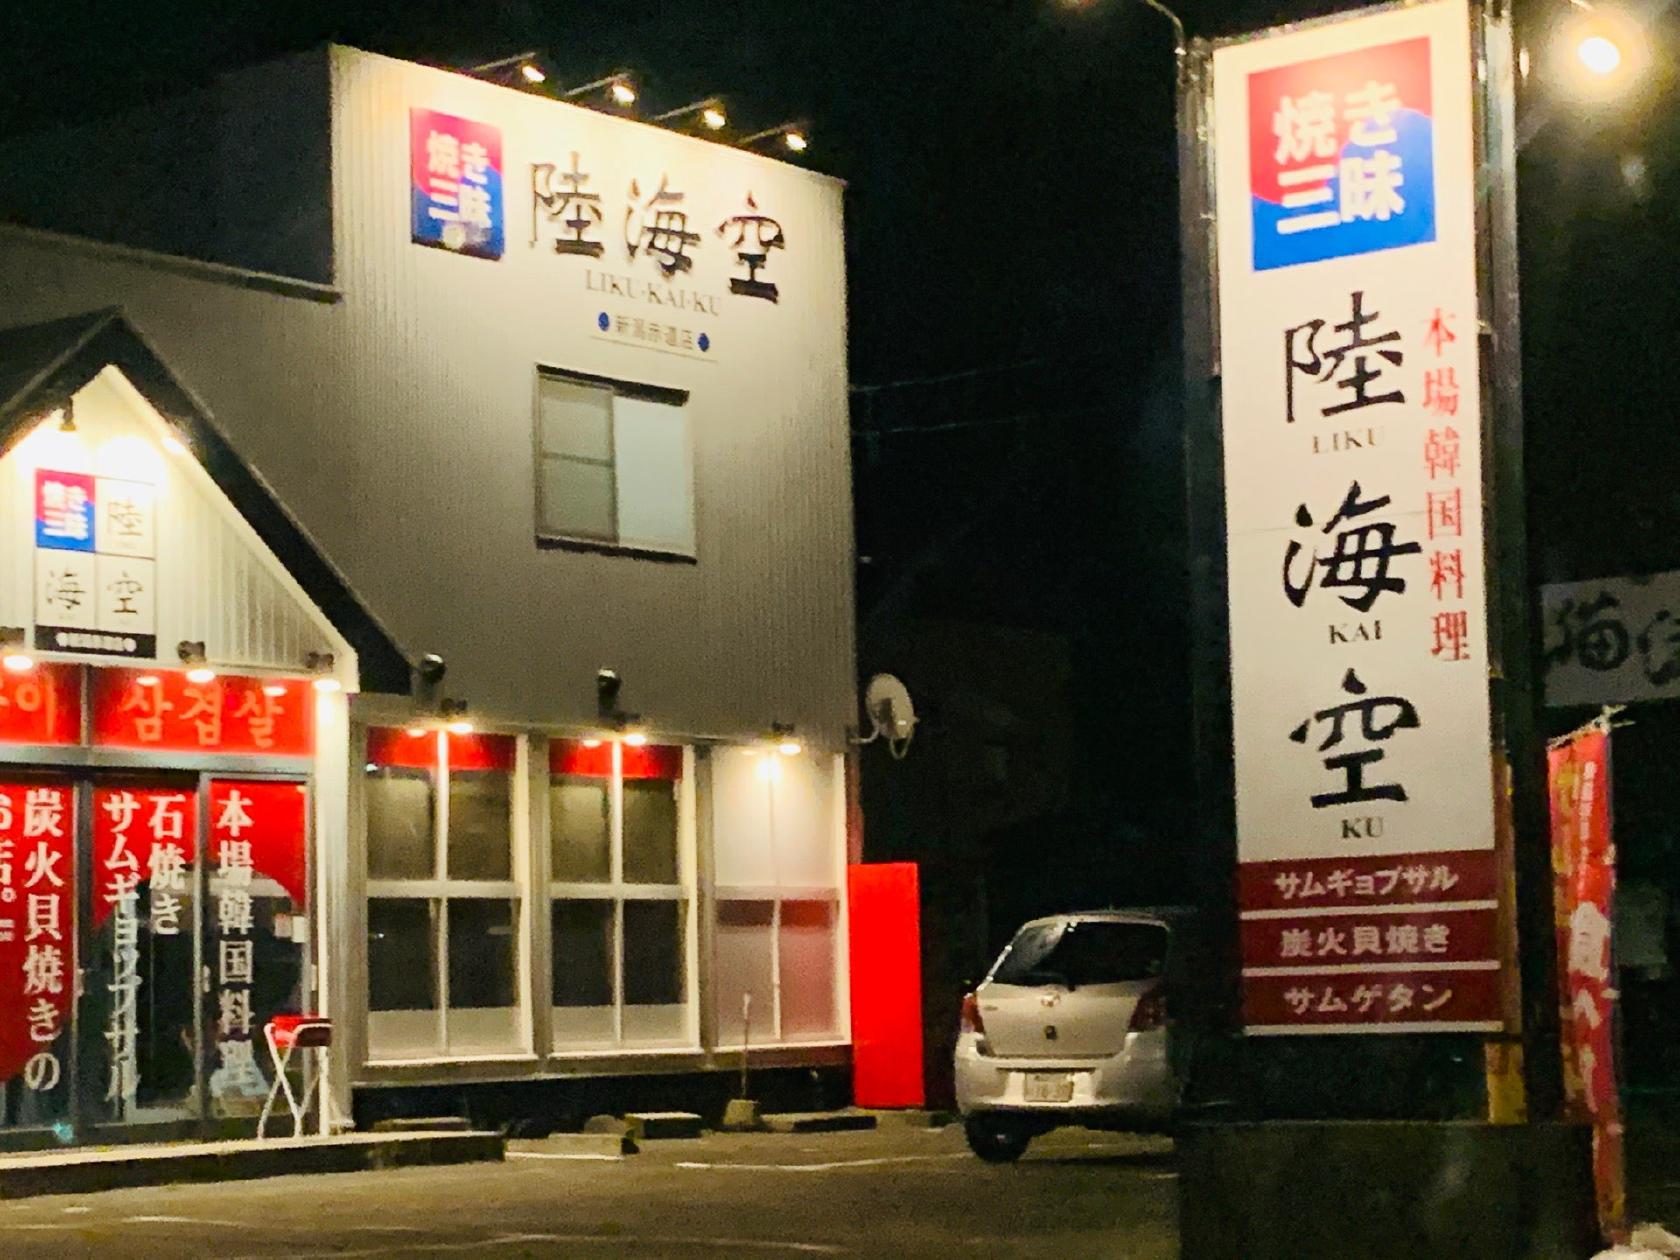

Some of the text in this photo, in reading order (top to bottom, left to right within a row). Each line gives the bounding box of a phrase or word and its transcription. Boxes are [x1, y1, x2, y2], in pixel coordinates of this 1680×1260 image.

[426, 129, 490, 184] 焼き
[1273, 79, 1401, 165] 焼き
[428, 176, 491, 229] 三味
[528, 150, 787, 305] 陸海空
[1277, 149, 1405, 235] 三味
[1285, 291, 1405, 423] 陸
[1312, 426, 1386, 455] LIKU
[1421, 306, 1471, 662] 本場韓国料理
[1282, 479, 1423, 613] 海
[1328, 619, 1382, 645] KAI
[1288, 667, 1421, 809] 空
[147, 792, 187, 936] 石焼き
[1341, 816, 1385, 840] KU
[22, 787, 65, 1092] 炭火貝焼きの
[1279, 922, 1451, 958] 炭火貝焼き
[1284, 983, 1453, 1015] サムゲタン
